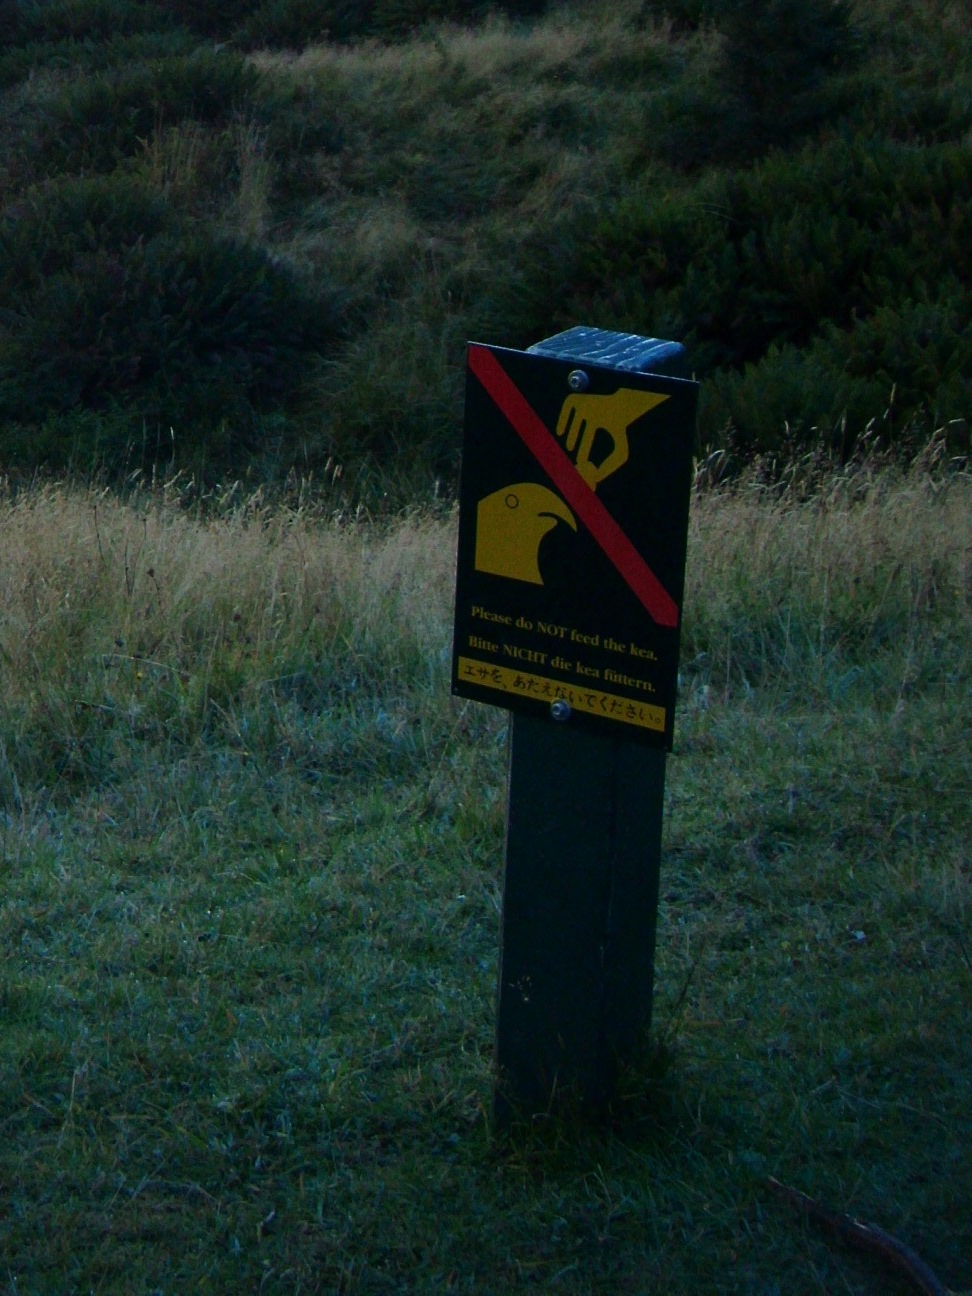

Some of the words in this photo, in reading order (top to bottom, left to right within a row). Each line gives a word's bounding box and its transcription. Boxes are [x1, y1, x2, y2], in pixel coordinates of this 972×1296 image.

[468, 635, 499, 653] Bitte
[503, 644, 547, 664] NICHT
[551, 656, 572, 671] die
[576, 661, 600, 678] kea
[471, 605, 513, 625] Please
[515, 616, 533, 630] do
[537, 621, 568, 638] NOT
[570, 629, 599, 646] feed
[604, 637, 626, 653] the
[630, 643, 658, 661] kea.
